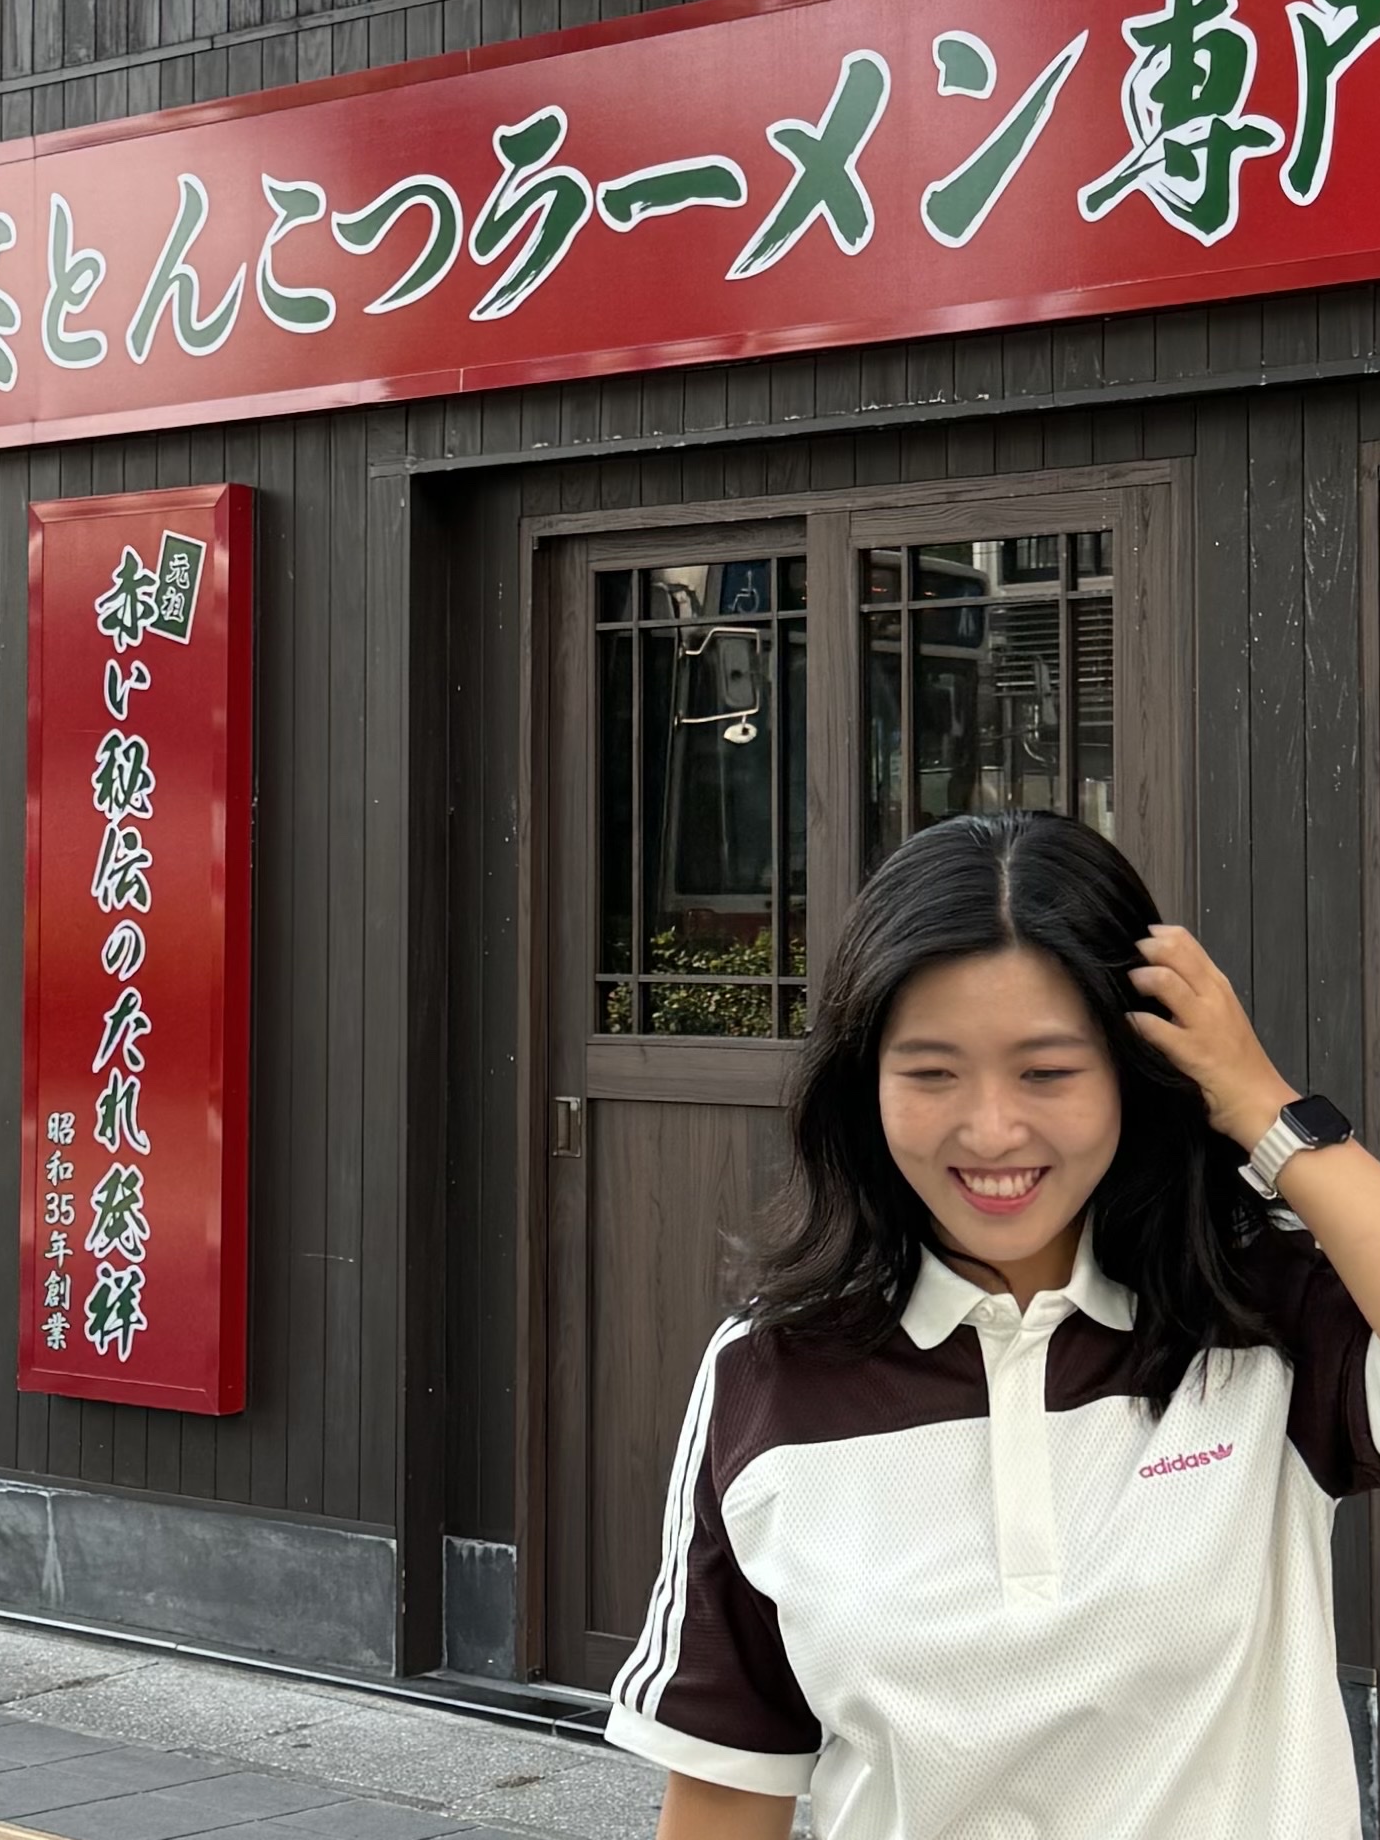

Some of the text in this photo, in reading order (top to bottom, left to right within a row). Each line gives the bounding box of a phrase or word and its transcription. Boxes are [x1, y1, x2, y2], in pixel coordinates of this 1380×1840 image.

[161, 553, 190, 623] 元祖
[41, 1111, 76, 1351] 昭和35年創業
[1138, 1452, 1211, 1479] adidas
